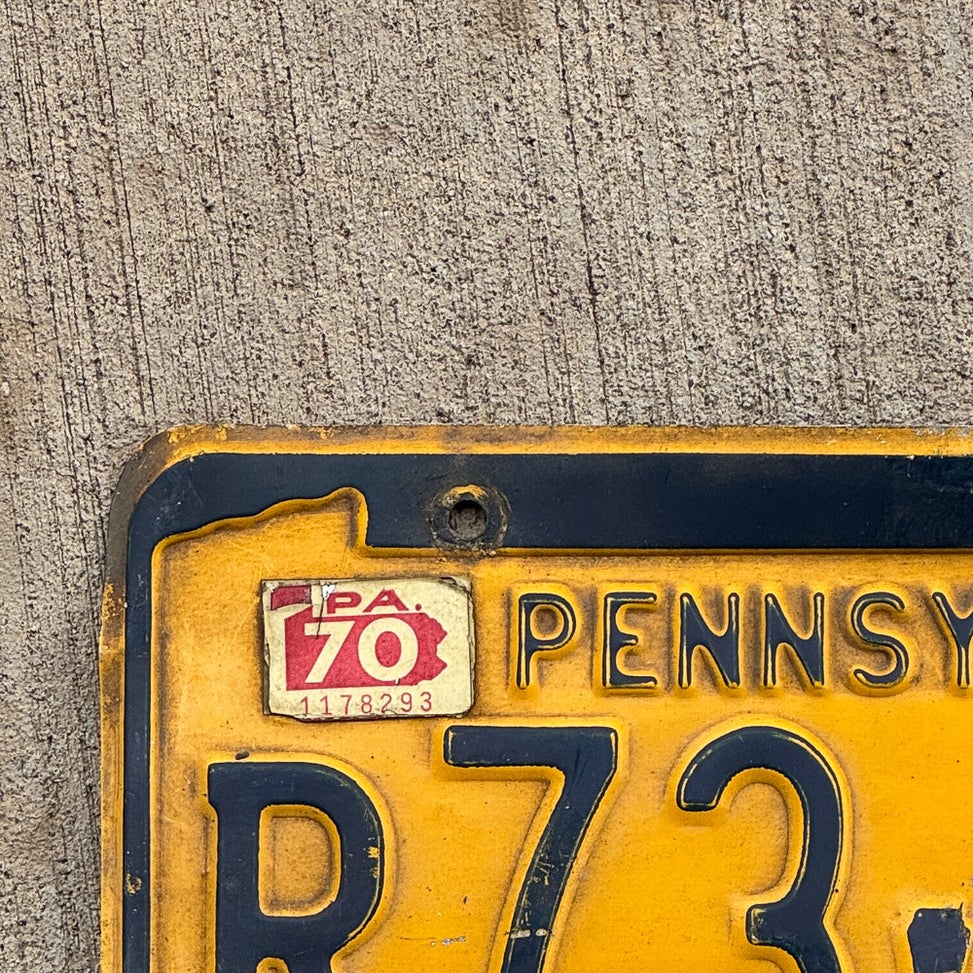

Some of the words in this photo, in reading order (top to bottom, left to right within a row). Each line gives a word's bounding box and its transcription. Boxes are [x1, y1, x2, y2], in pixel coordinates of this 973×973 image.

[327, 588, 422, 614] PA.
[304, 617, 418, 683] 70
[300, 691, 433, 716] 1178293
